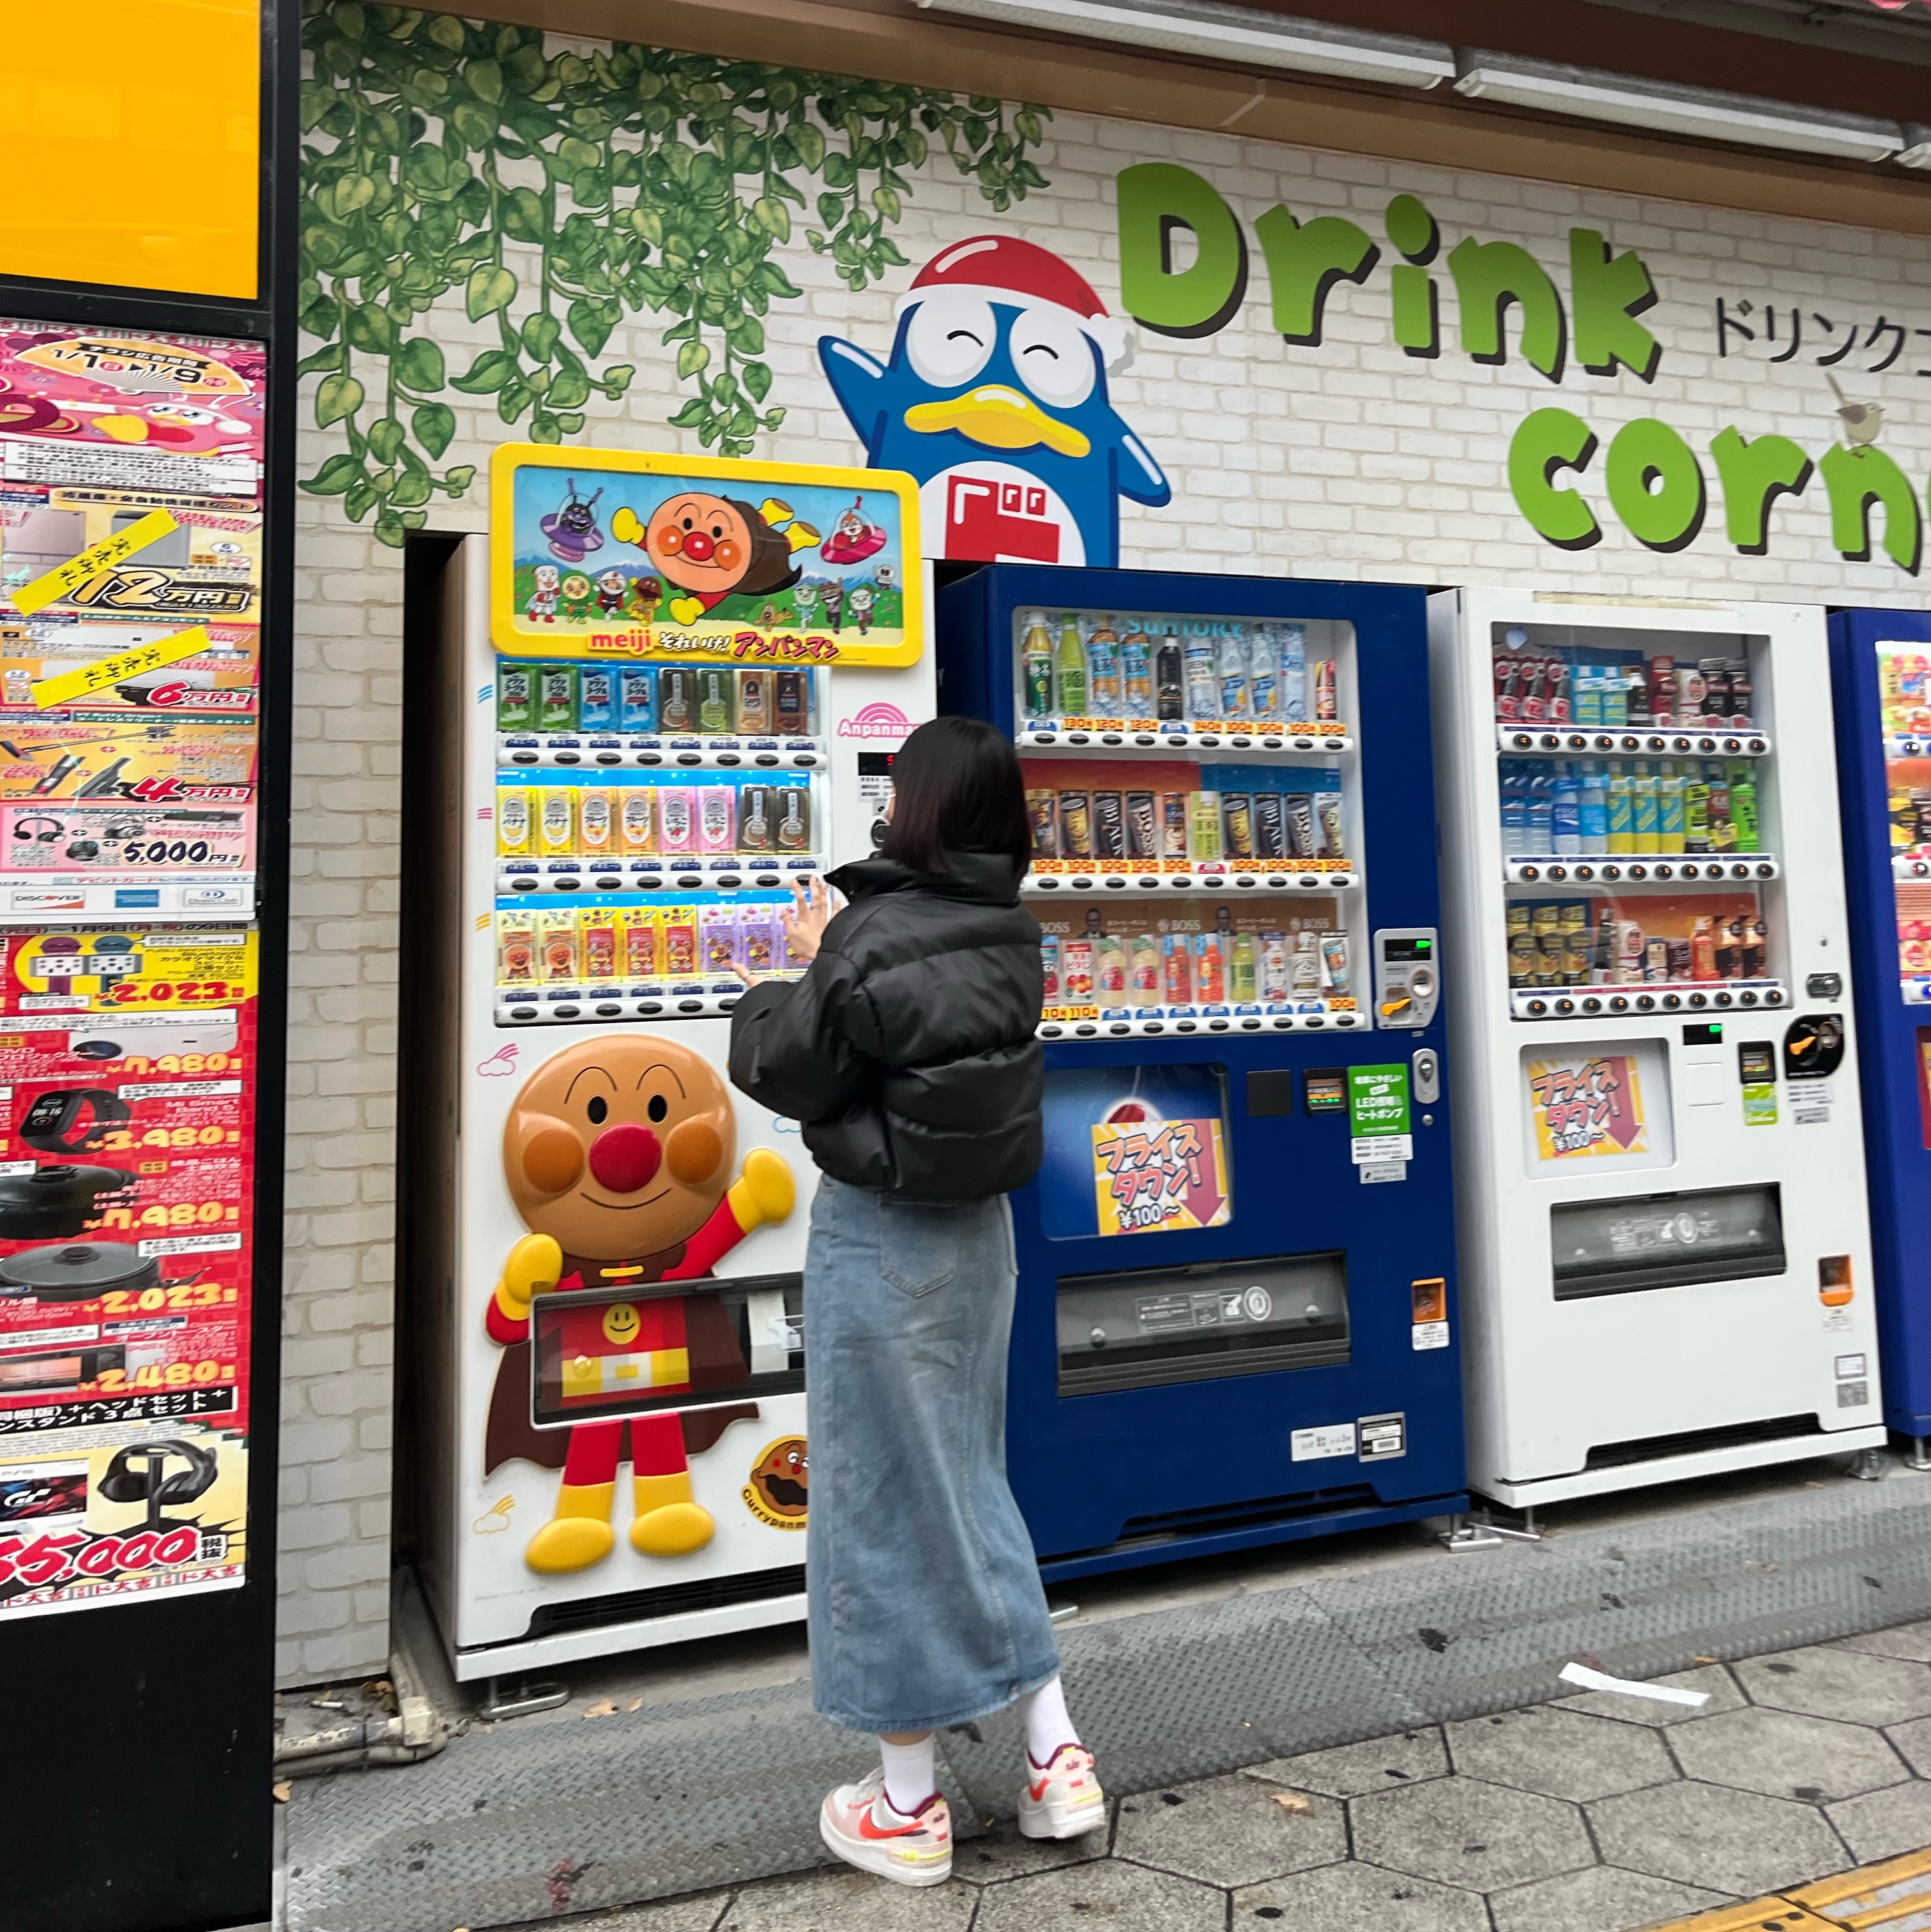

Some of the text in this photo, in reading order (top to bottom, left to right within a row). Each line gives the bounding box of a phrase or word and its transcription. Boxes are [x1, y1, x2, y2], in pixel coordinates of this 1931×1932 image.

[1117, 162, 1662, 384] Drink
[1509, 407, 1931, 577] corn
[1127, 616, 1242, 638] SUNTORY
[590, 628, 652, 655] meiji
[733, 631, 841, 660] アンパンマン
[148, 680, 233, 706] 6万円
[838, 719, 924, 739] Anpanma
[132, 776, 233, 802] 4万円
[1044, 1008, 1066, 1017] 10円
[85, 1125, 225, 1151] ¥3,980
[78, 1360, 220, 1392] ¥2,480
[742, 1488, 807, 1530] Currypanm
